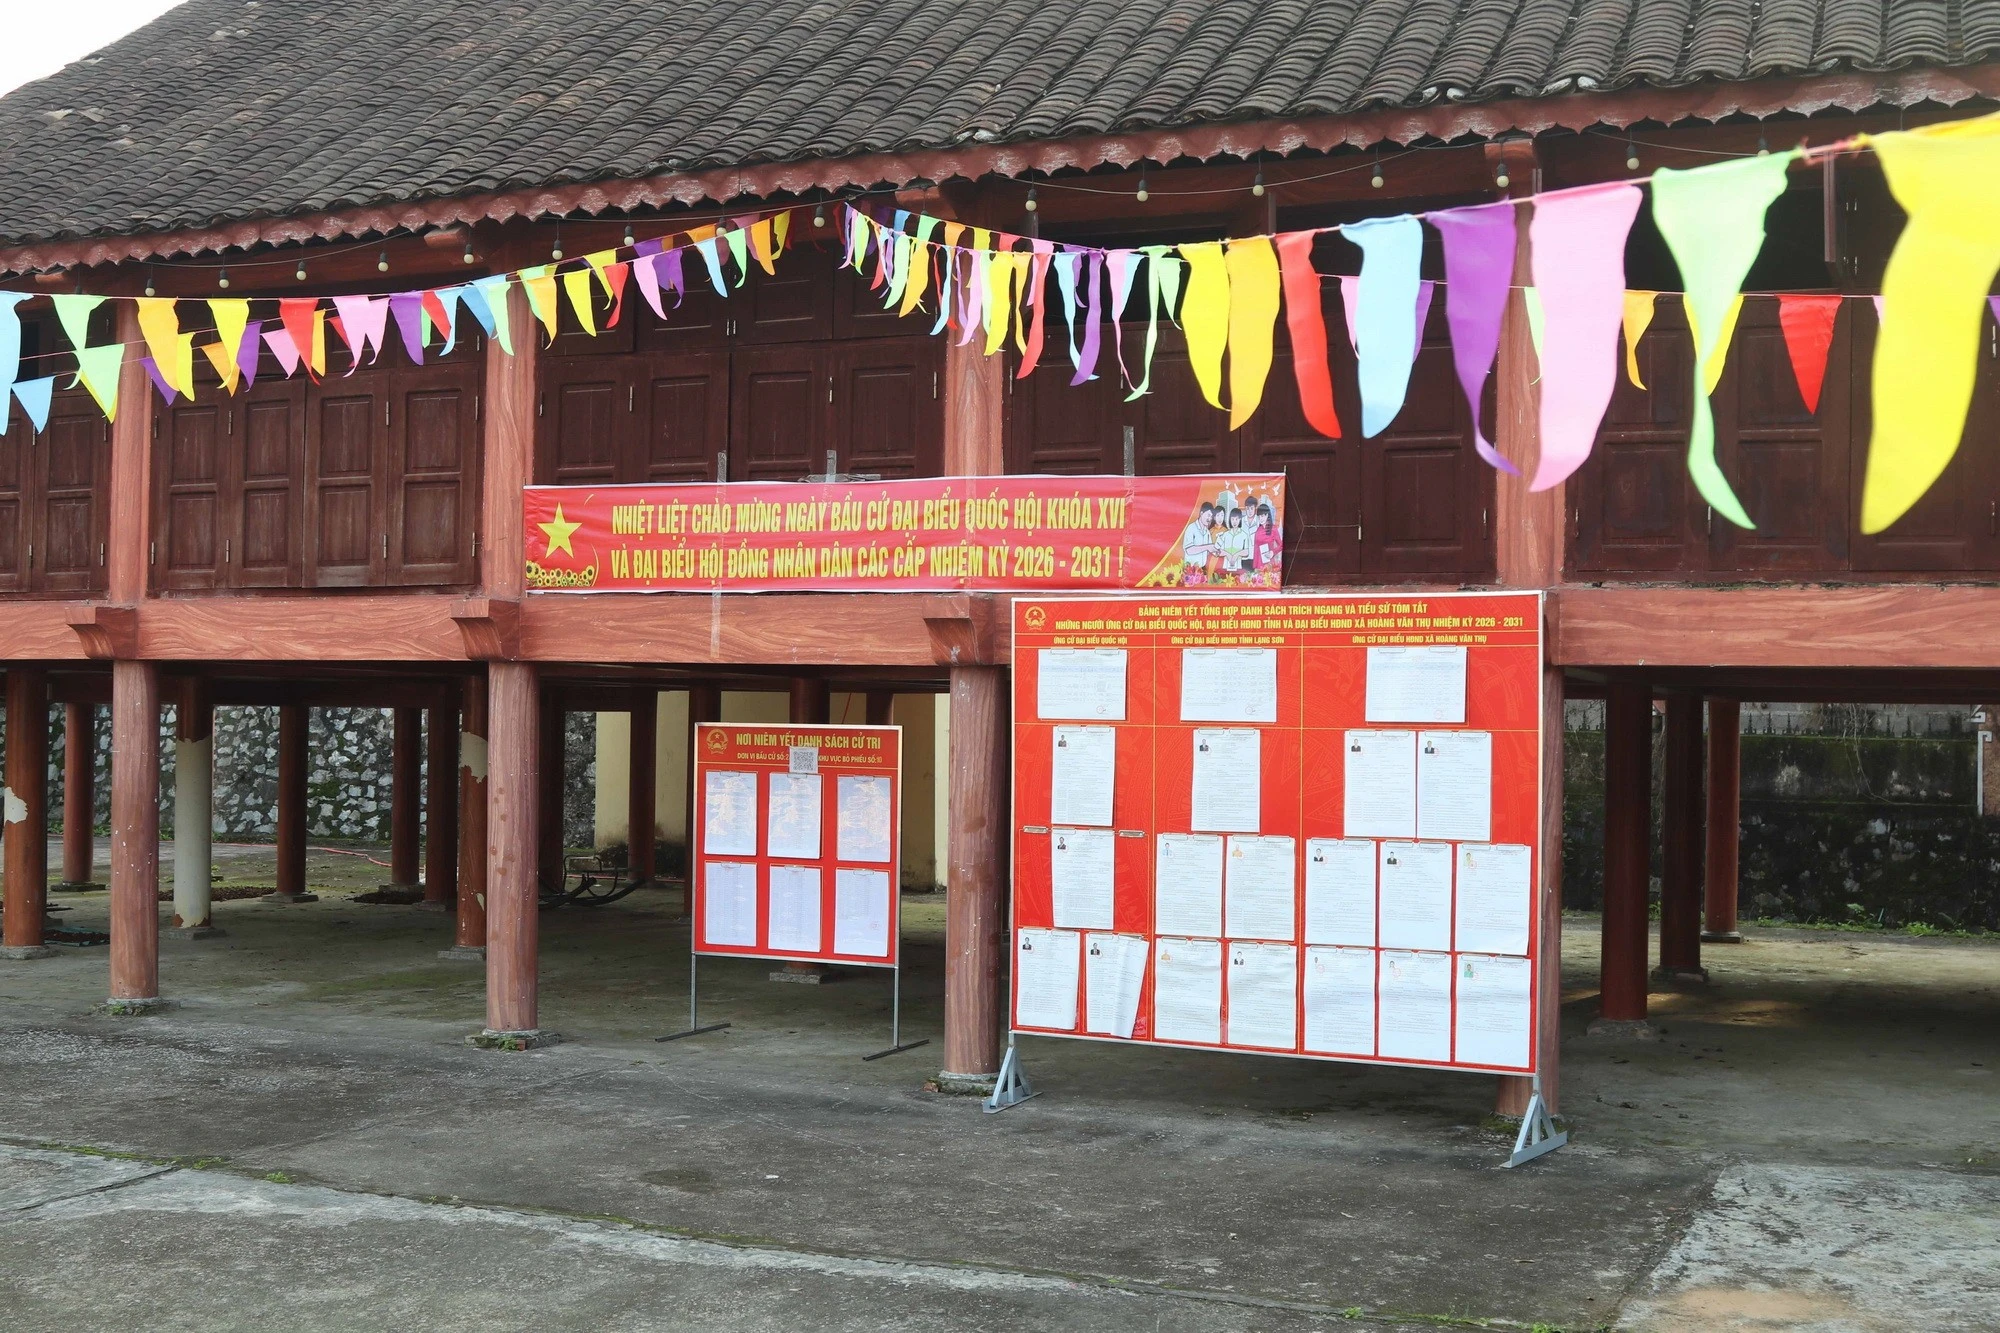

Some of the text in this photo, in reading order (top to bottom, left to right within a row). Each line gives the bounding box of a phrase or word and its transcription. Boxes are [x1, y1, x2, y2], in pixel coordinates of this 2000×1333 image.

[612, 486, 1126, 540] NHIỆT LIỆT CHÀO MỪNG NGÀY BẦU CỬ ĐẠI BIỂU QUỐC HỘI KHÓA XVI
[611, 544, 630, 578] VÀ
[633, 550, 658, 585] ĐẠI
[662, 537, 694, 579] BIỂU
[699, 543, 724, 586] HỘI
[728, 539, 768, 578] ĐỒNG
[773, 542, 816, 578] NHÂN
[820, 542, 852, 577] DÂN
[858, 538, 888, 577] CÁC
[893, 536, 925, 577] CẤP
[930, 540, 982, 584] NHIỆM
[988, 540, 1009, 576] KỲ
[1014, 546, 1054, 577] 2026
[1070, 546, 1110, 578] 2031
[1118, 546, 1124, 577] !
[1138, 601, 1428, 617] BẢNG NIÊM YẾT TỔNG HỢP DANH SÁCH TRÍCH NGANG VÀ TIỂU SỬ TÓM TẮT
[736, 731, 880, 749] NƠI NIÊM YẾT DANH SÁCH CỬ TRI
